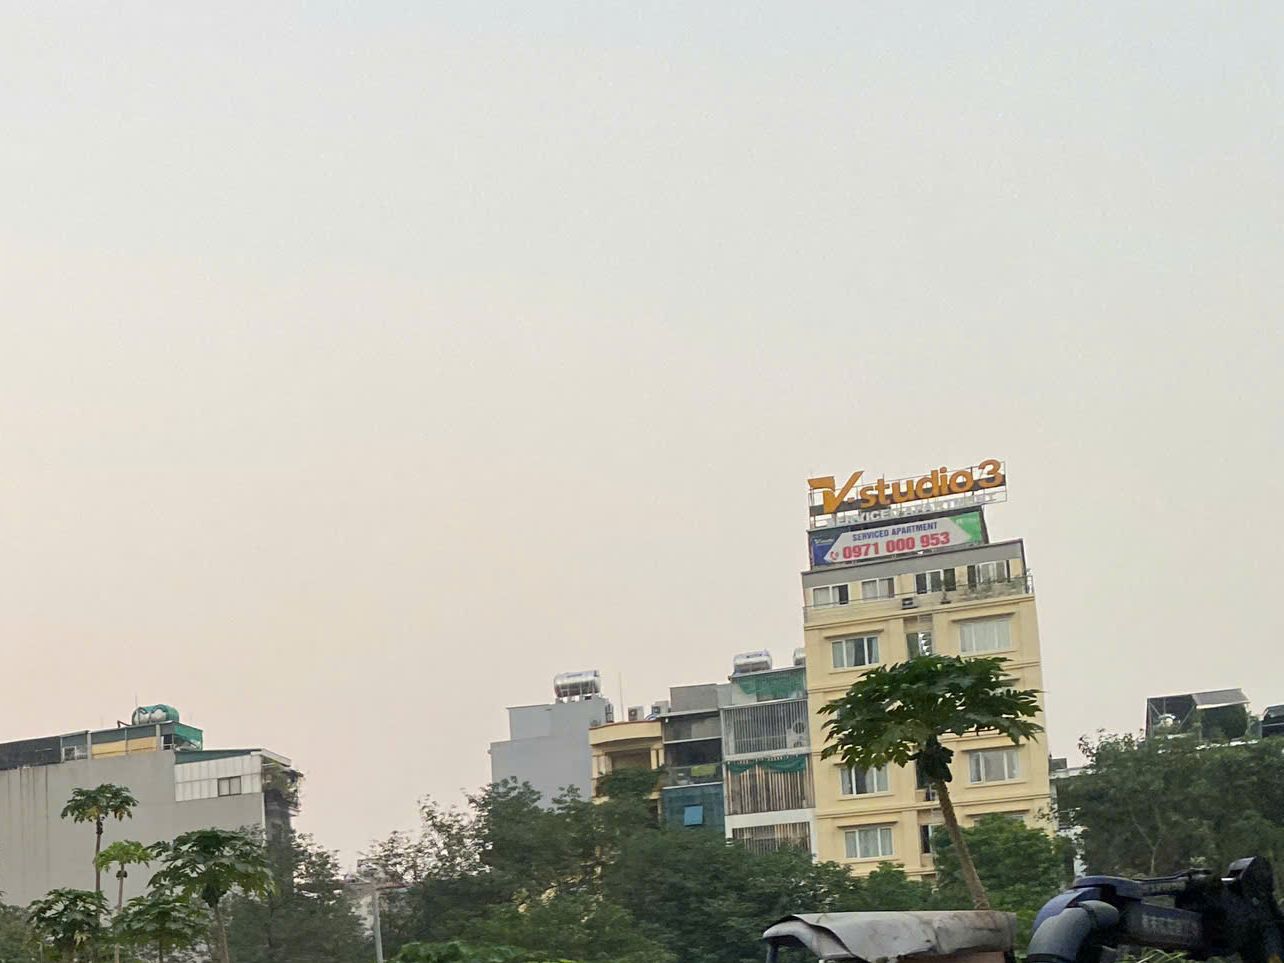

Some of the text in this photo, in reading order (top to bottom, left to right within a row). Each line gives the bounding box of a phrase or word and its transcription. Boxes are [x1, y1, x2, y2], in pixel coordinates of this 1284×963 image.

[978, 459, 1005, 489] 3
[842, 531, 950, 559] 0971 000 953
[852, 521, 938, 541] SERVICED APARTMENT
